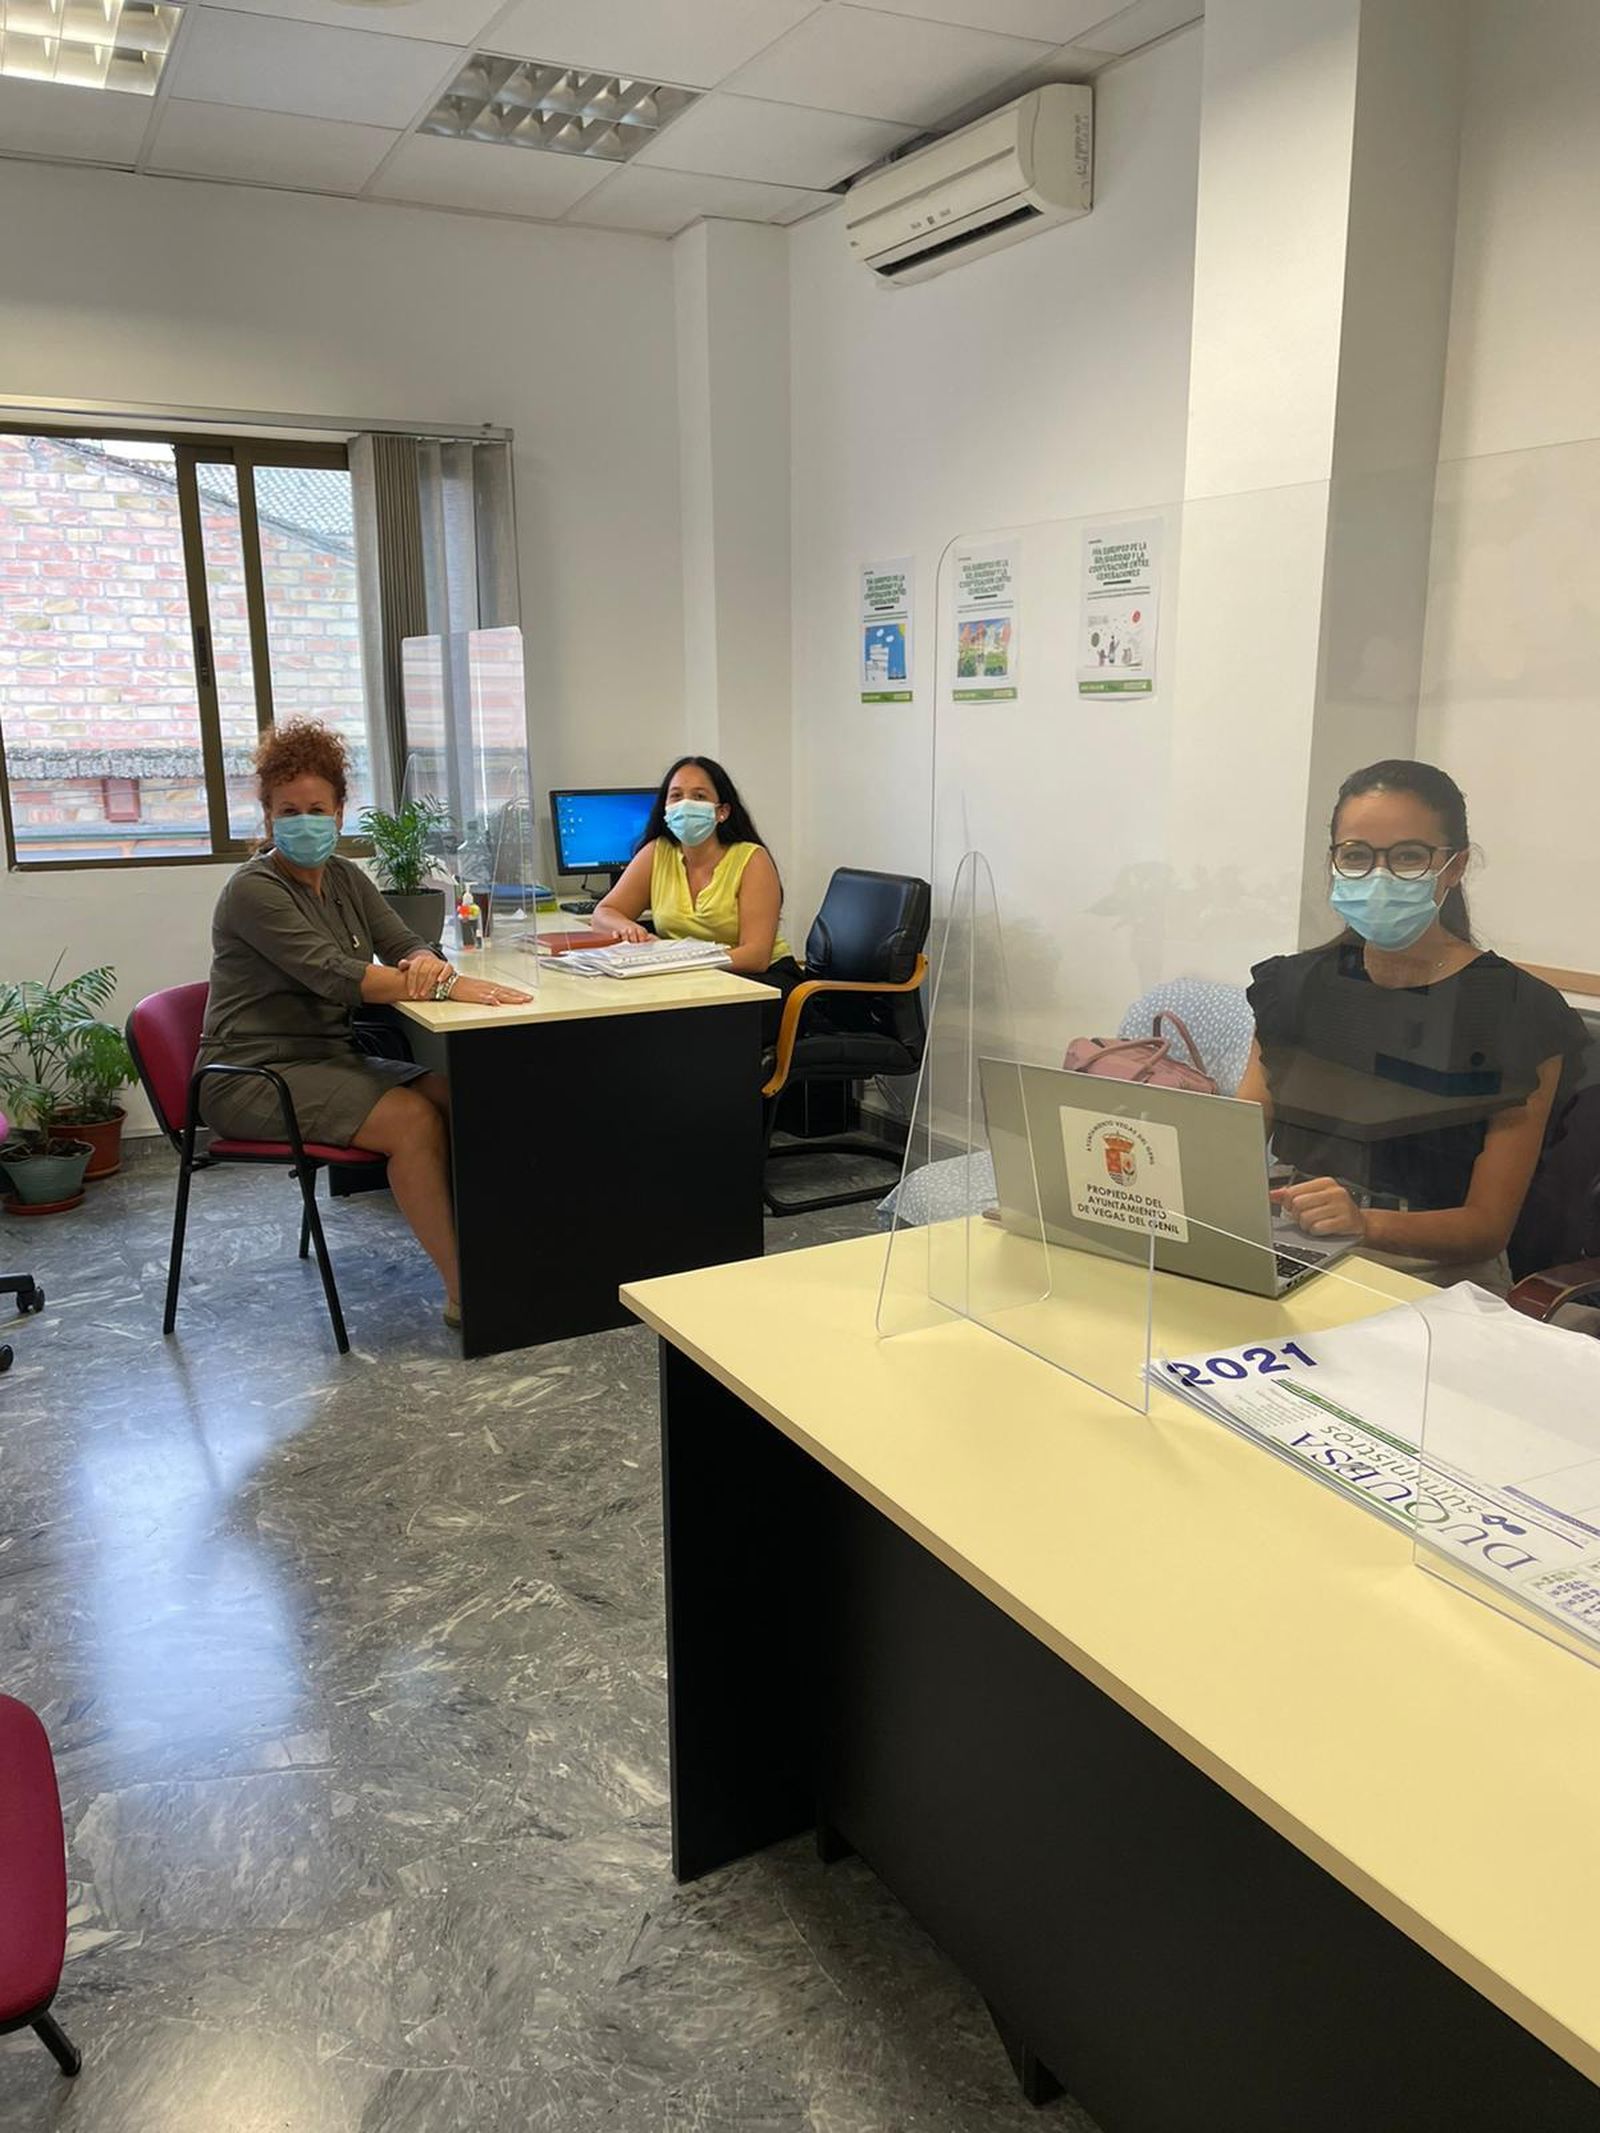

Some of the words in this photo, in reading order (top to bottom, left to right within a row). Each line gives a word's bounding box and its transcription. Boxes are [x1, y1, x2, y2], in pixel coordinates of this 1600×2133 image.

[1116, 1122, 1137, 1135] VEGAS
[1087, 1184, 1143, 1203] PROPIEDAD
[1145, 1197, 1163, 1209] DEL
[1088, 1196, 1167, 1220] AYUNTAMIENTO
[1077, 1203, 1090, 1214] DE
[1093, 1206, 1125, 1222] VEGAS
[1129, 1215, 1145, 1227] DEL
[1148, 1218, 1180, 1234] GENIL
[1167, 1341, 1318, 1389] 2021
[1320, 1424, 1485, 1515] suministros
[1289, 1431, 1539, 1575] DUQUESA
